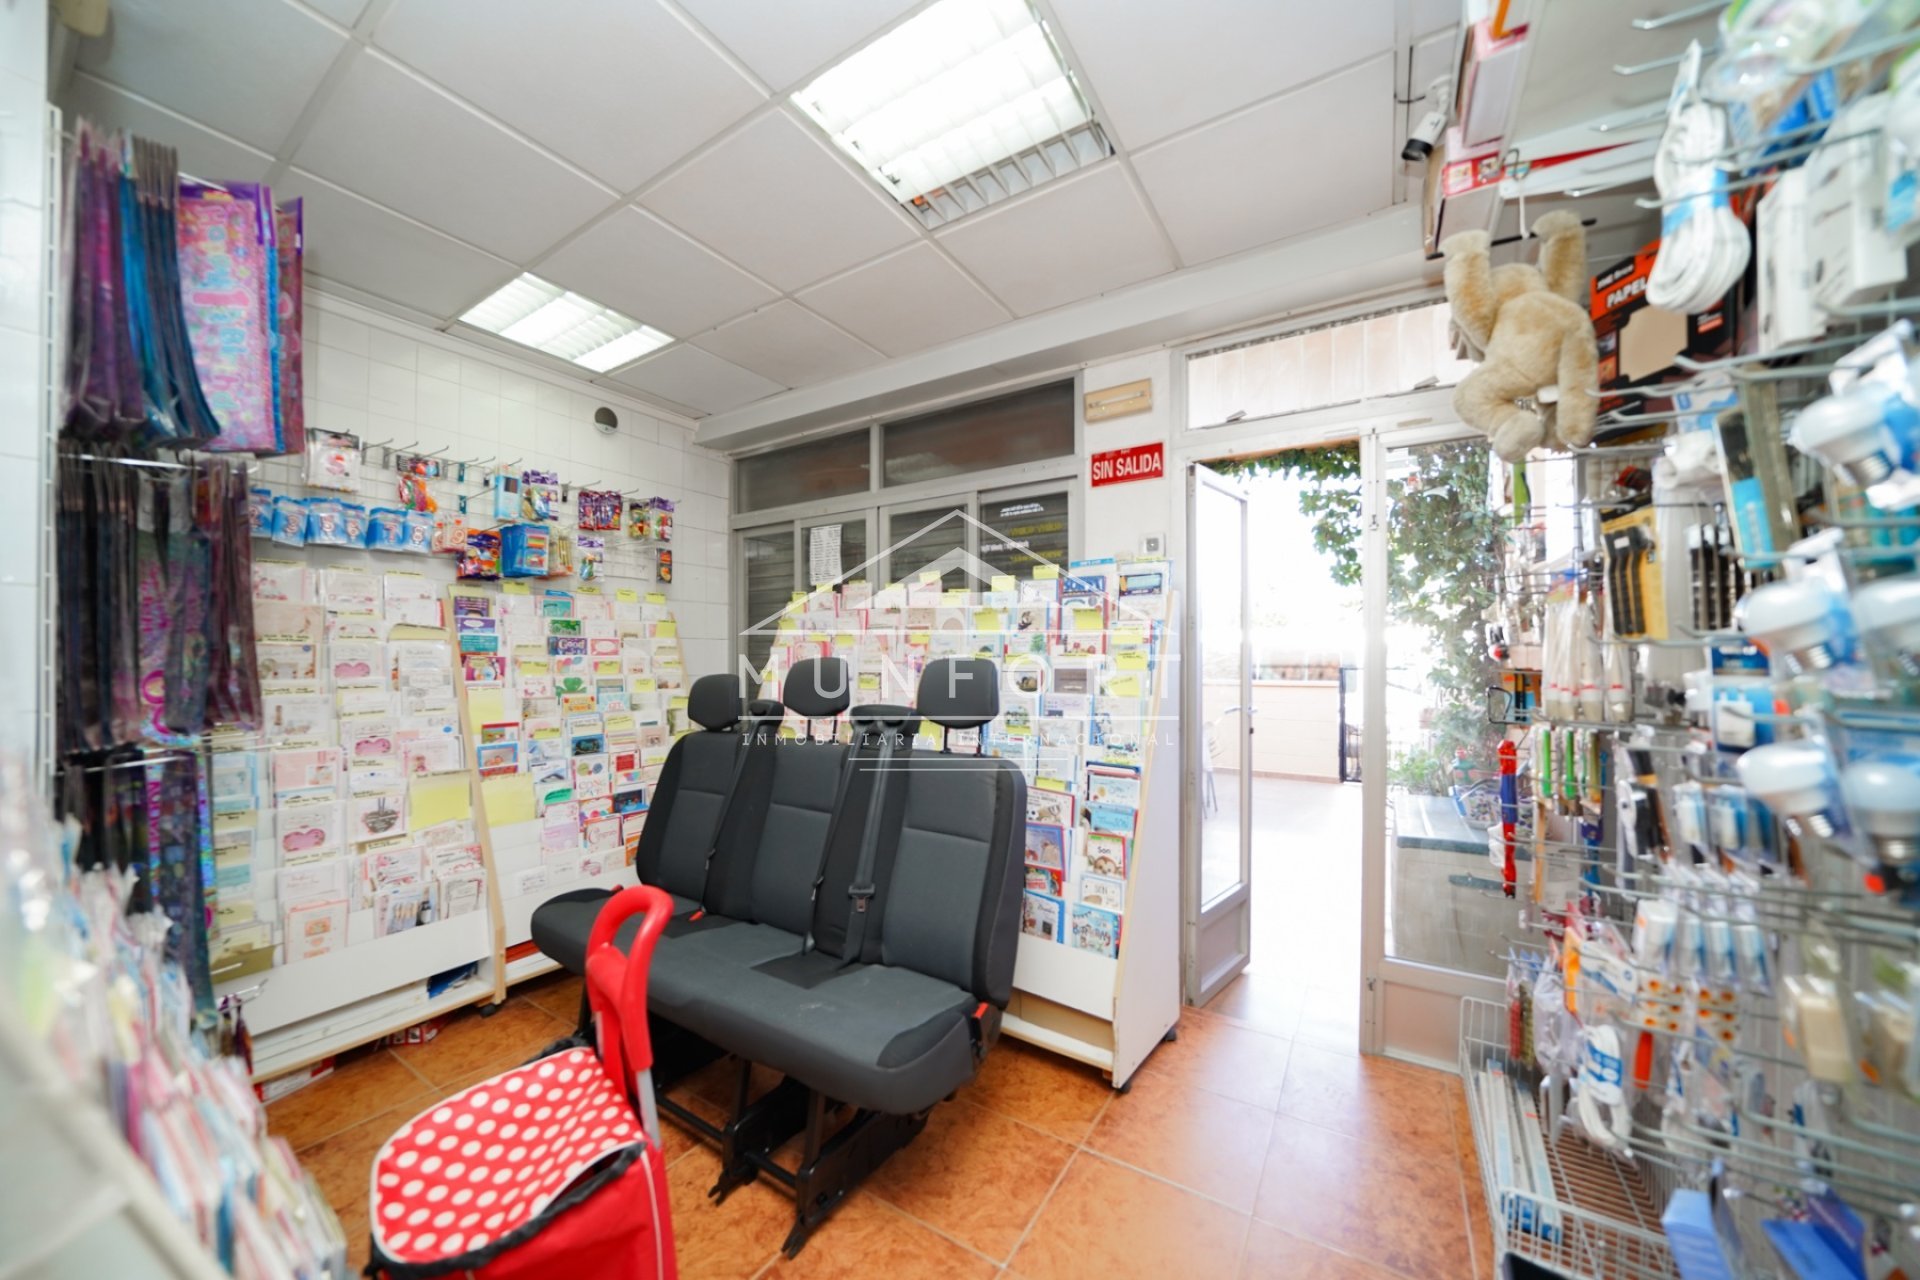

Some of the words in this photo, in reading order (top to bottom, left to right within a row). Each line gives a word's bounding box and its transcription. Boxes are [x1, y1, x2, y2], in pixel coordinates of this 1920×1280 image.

[1606, 277, 1649, 308] PAPEL
[1093, 459, 1113, 481] SIN
[1116, 452, 1162, 477] SALIDA
[1097, 846, 1112, 855] Son
